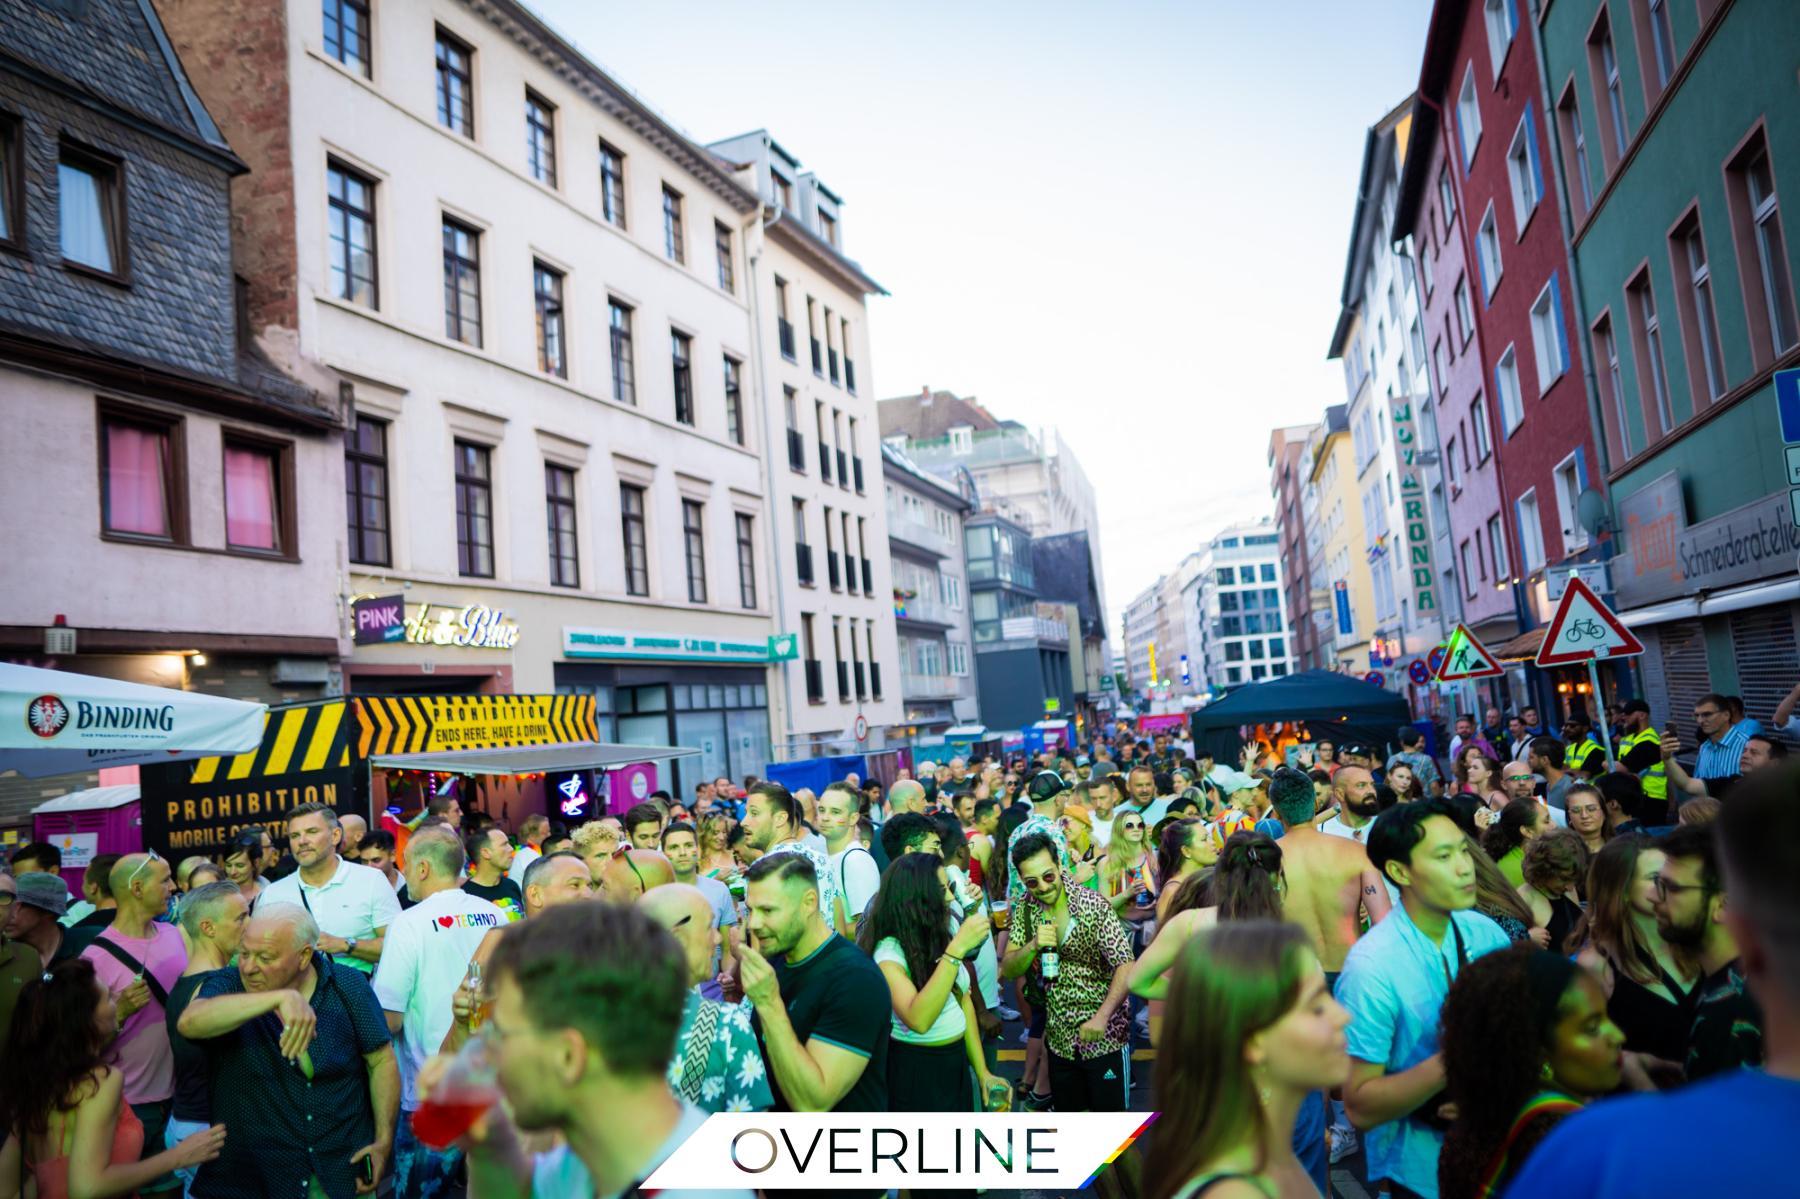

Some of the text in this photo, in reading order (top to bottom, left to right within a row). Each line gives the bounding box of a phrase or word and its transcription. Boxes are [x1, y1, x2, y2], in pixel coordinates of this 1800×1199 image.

[1405, 501, 1435, 610] RONDA
[359, 606, 400, 630] PINK
[77, 701, 175, 732] BINDING
[433, 706, 545, 722] PROHIBITION
[436, 728, 460, 742] ENDS
[492, 726, 514, 739] HAVE
[516, 726, 522, 737] A
[524, 725, 547, 737] DRINK
[167, 783, 337, 822] PROHIBITION
[169, 826, 226, 849] MOBILE
[432, 913, 497, 932] I TECHNO
